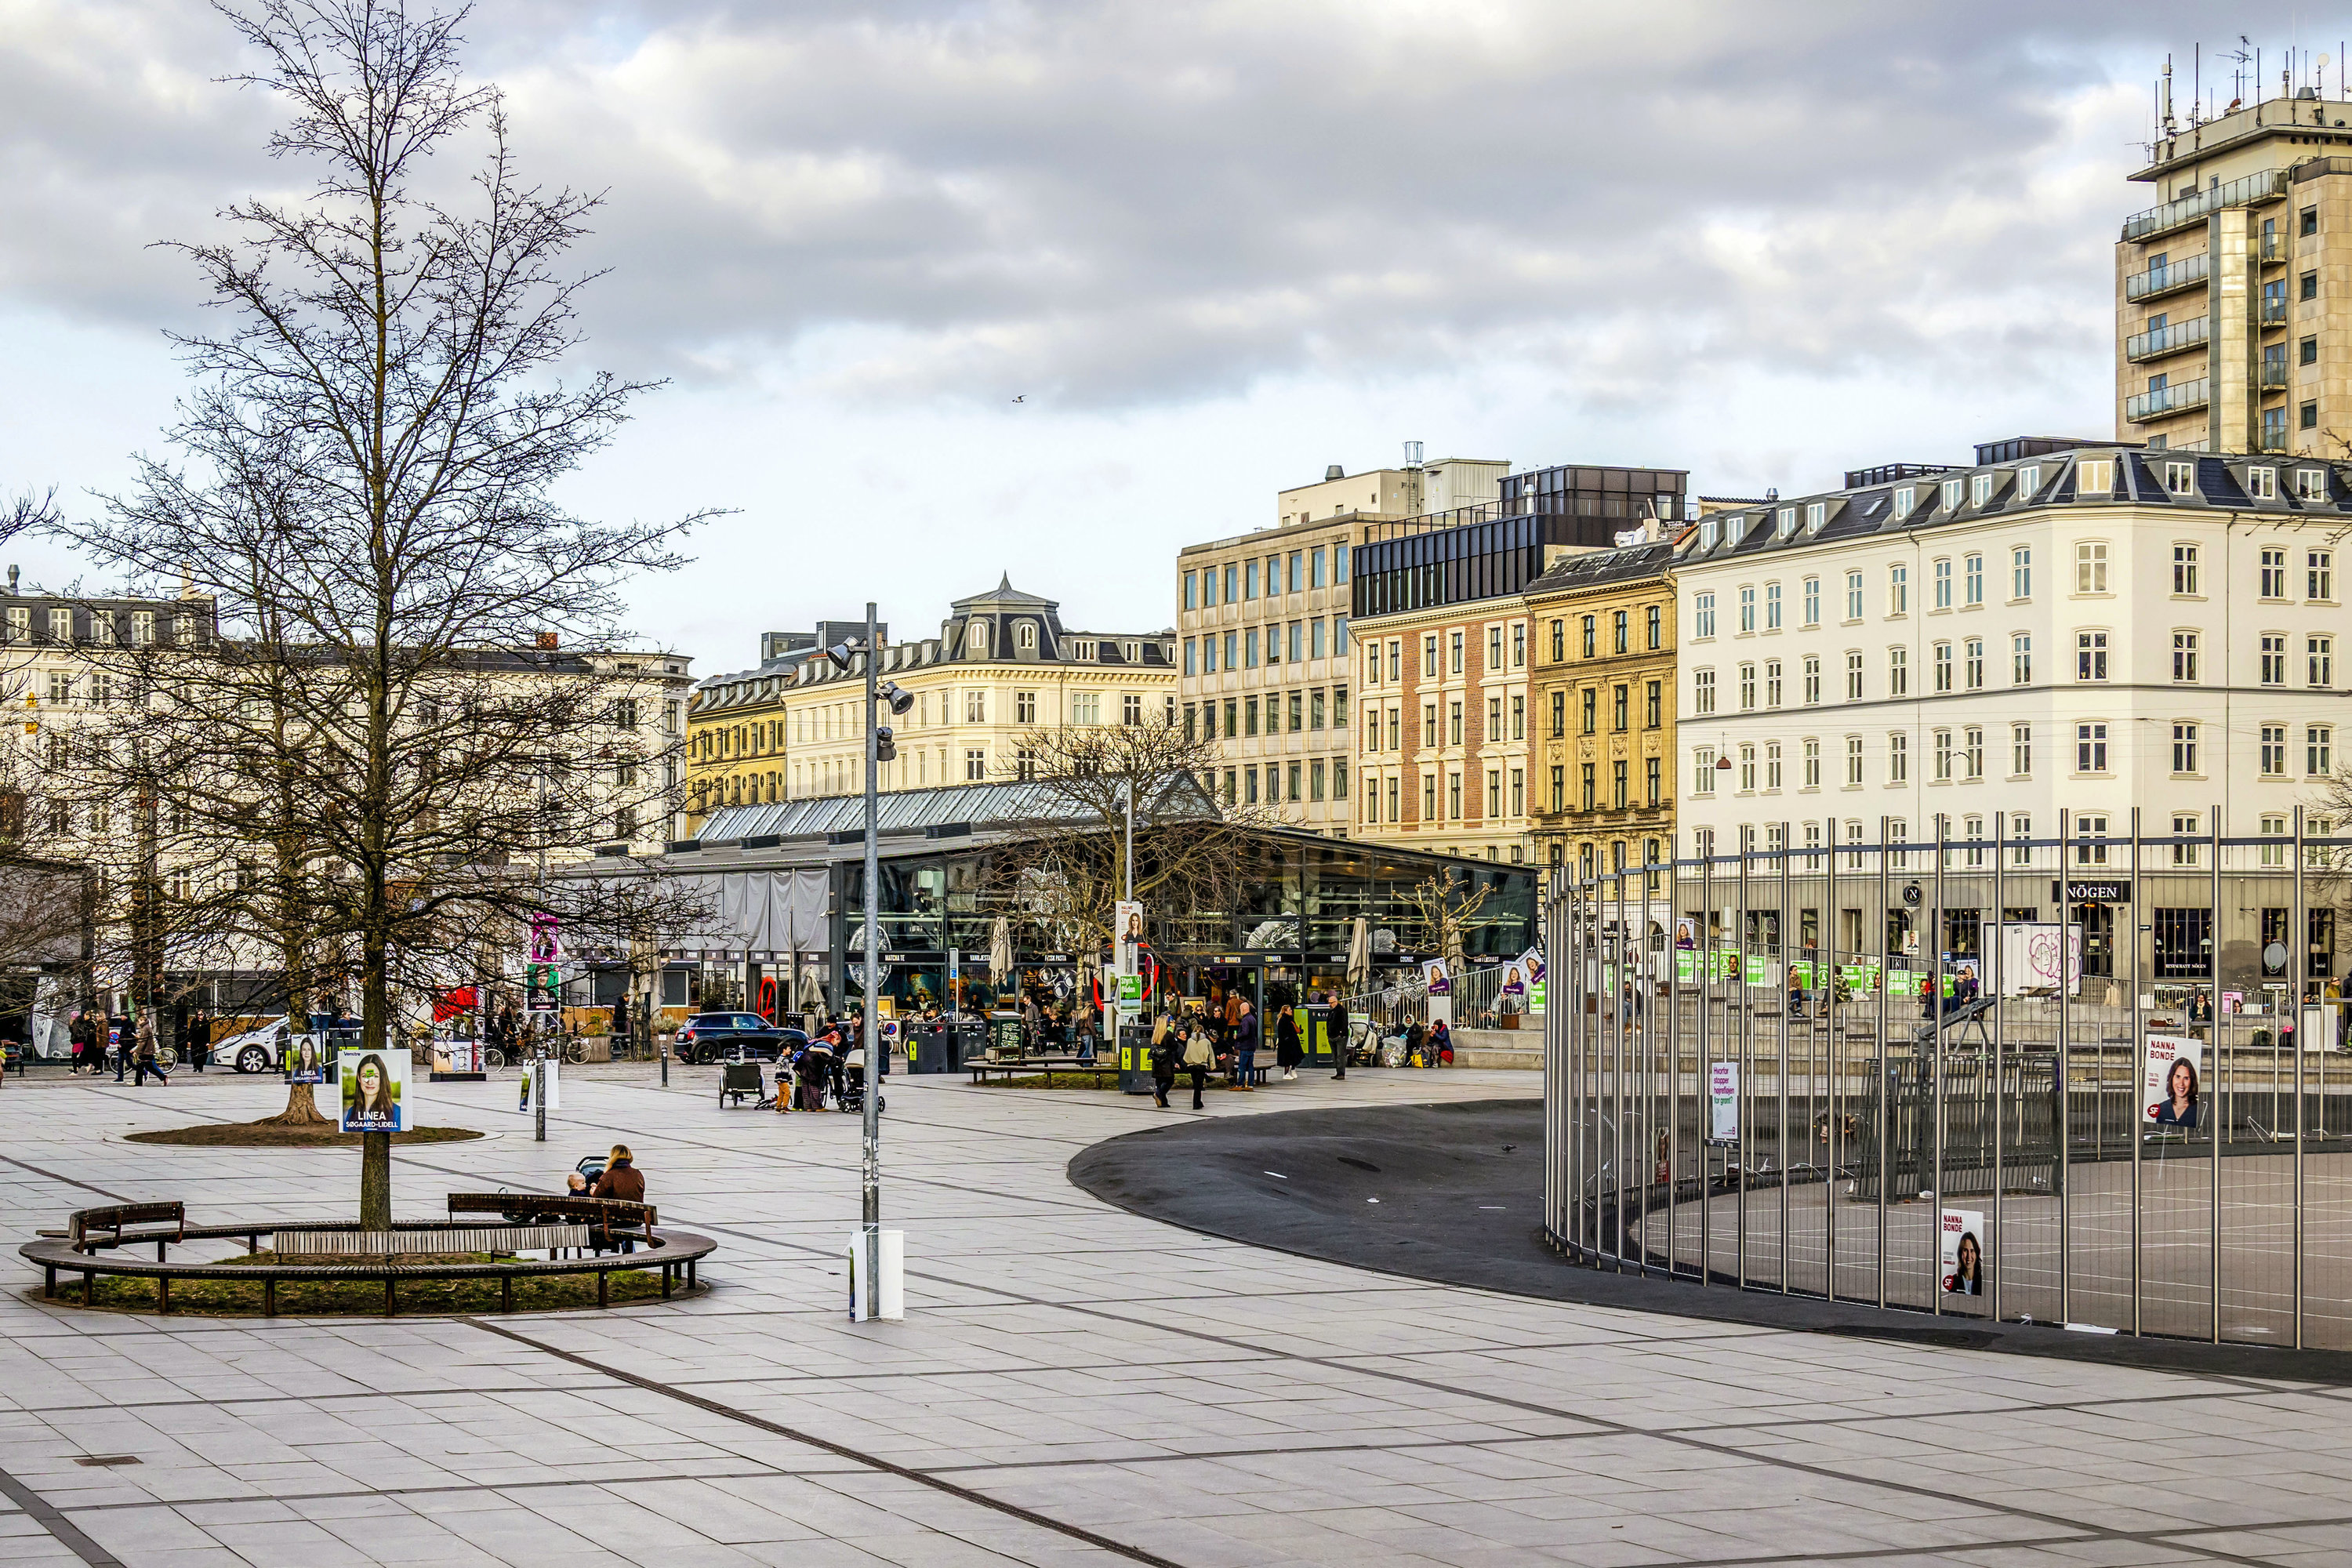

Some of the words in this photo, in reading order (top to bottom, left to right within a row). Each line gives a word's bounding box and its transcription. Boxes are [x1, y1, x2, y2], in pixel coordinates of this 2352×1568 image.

[2151, 1040, 2176, 1051] NANNA
[2150, 1050, 2175, 1061] BONDE
[1713, 1076, 1730, 1085] stopper
[358, 1111, 387, 1120] LINEA
[1943, 1214, 1962, 1224] NANNA
[1943, 1223, 1962, 1232] BONDE
[1944, 1278, 1952, 1287] SF
